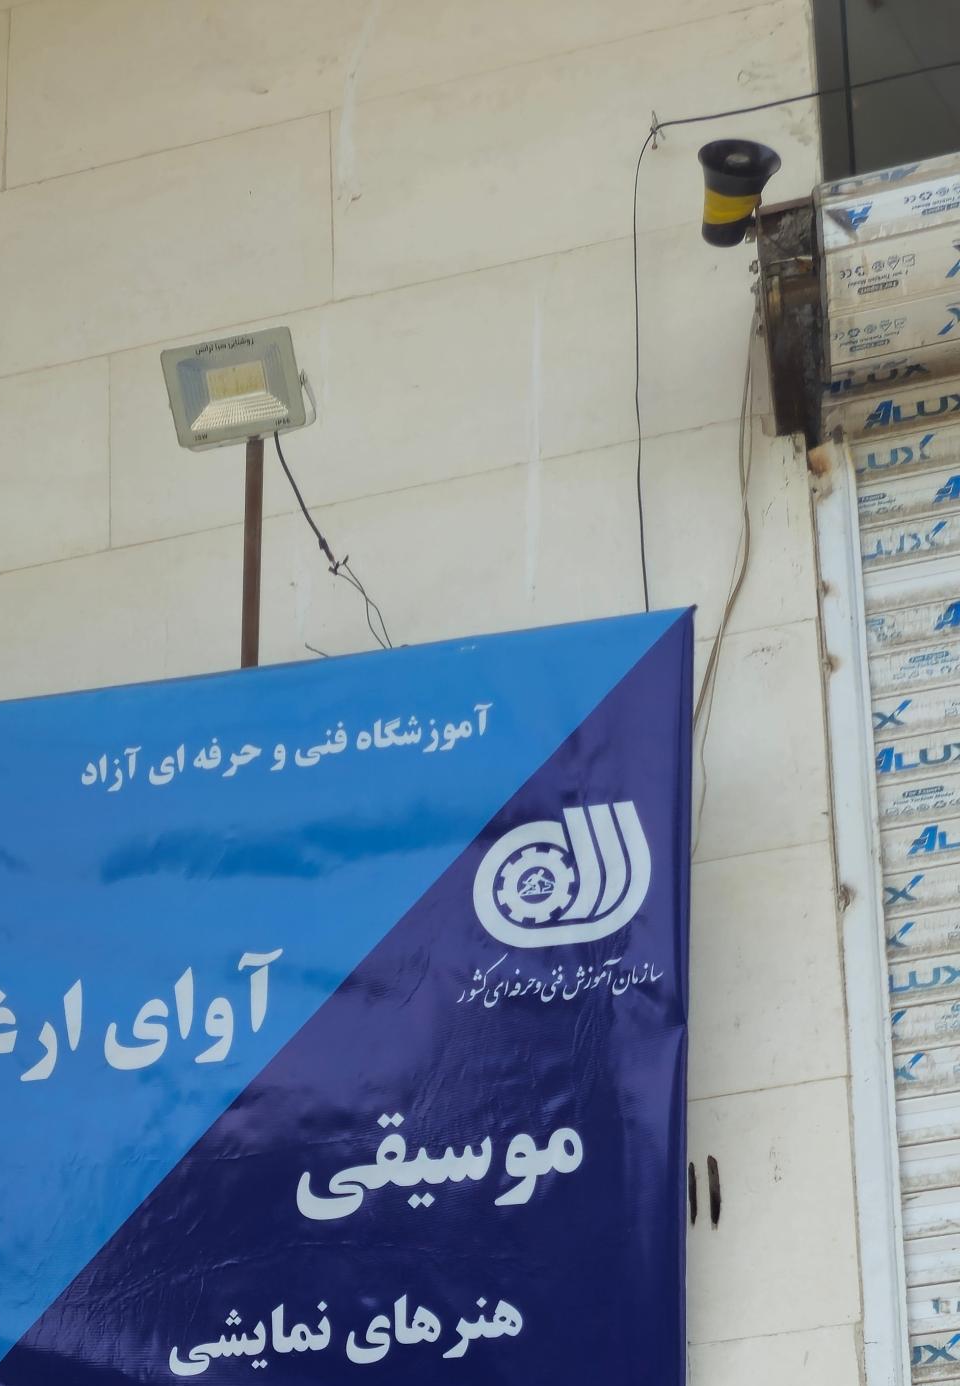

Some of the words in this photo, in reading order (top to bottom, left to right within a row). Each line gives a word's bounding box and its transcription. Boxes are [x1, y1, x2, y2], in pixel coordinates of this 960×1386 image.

[294, 721, 348, 768] فنی
[356, 703, 493, 753] آموزشگاه
[81, 746, 142, 792] آزاد
[148, 743, 185, 785] ای
[193, 737, 262, 777] حرفه
[270, 743, 286, 771] و
[457, 953, 508, 1003] کشور
[563, 957, 622, 1000] آموزش
[612, 962, 664, 995] سازمان
[104, 948, 283, 1070] آوای
[296, 1112, 583, 1220] موسیقی
[169, 1301, 331, 1376] نمایشی
[346, 1295, 524, 1364] هنرهای
